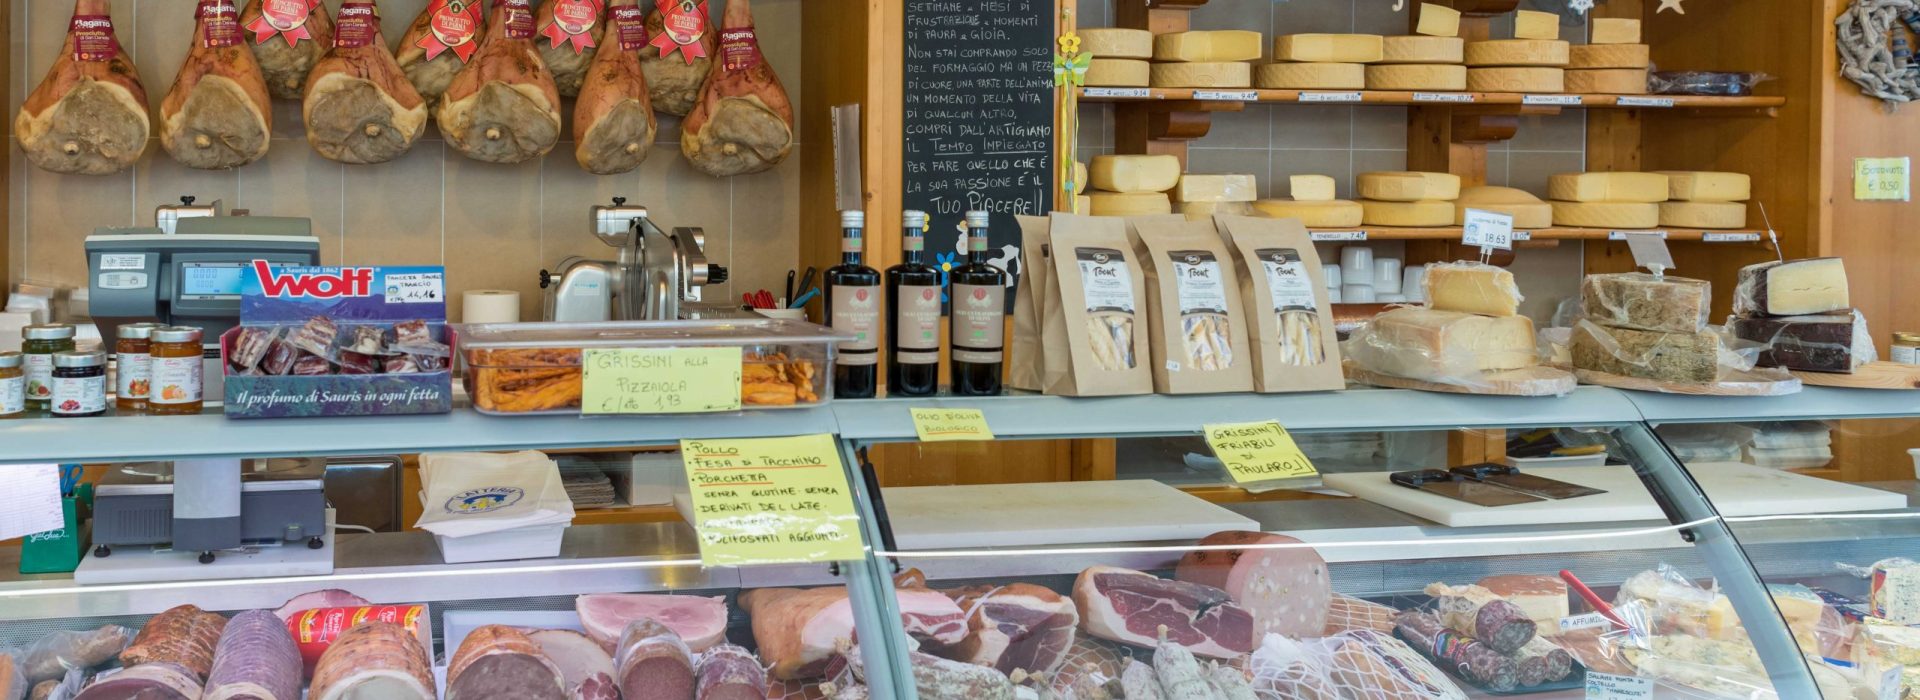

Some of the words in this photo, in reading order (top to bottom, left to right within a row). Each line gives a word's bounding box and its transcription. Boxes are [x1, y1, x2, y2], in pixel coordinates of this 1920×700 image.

[560, 3, 592, 13] PROSCIUTTO
[439, 14, 471, 26] PROSCIUTTO
[926, 29, 957, 39] PAURA
[960, 48, 1018, 58] COMPRANDO
[1022, 47, 1049, 56] SOLO
[908, 63, 927, 73] DEL
[932, 62, 995, 73] FORMAGGIO
[1000, 63, 1013, 72] MA
[1017, 62, 1028, 72] UN
[956, 79, 973, 89] UNA
[976, 78, 1001, 89] PARTE
[906, 93, 919, 104] UN
[924, 94, 976, 105] MOMENTO
[982, 94, 1013, 104] DELLA
[924, 110, 974, 120] QUALCUN
[907, 161, 927, 173] PER
[932, 160, 960, 172] FARE
[966, 159, 1009, 170] QUELLO
[1013, 157, 1036, 169] CHE
[906, 180, 921, 194] LA
[928, 180, 948, 192] SUA
[322, 266, 338, 274] 1862
[252, 259, 374, 298] Wolf
[597, 353, 673, 369] GRISSINI
[684, 356, 709, 367] ALLA
[615, 376, 688, 394] PIZZAIOLA
[236, 390, 247, 404] Il
[246, 388, 303, 409] profumo
[305, 389, 319, 402] di
[320, 390, 361, 402] Sauris
[364, 390, 377, 401] in
[380, 389, 406, 406] ogni
[407, 386, 440, 406] fetta
[690, 441, 739, 455] POLLO
[693, 457, 733, 468] FESA
[759, 455, 822, 467] TACCHINO
[1228, 461, 1293, 476] PAULARO
[694, 472, 768, 484] PORCHETTA
[703, 489, 739, 499] SENZA
[804, 486, 839, 496] SENZA
[758, 501, 786, 512] DEL
